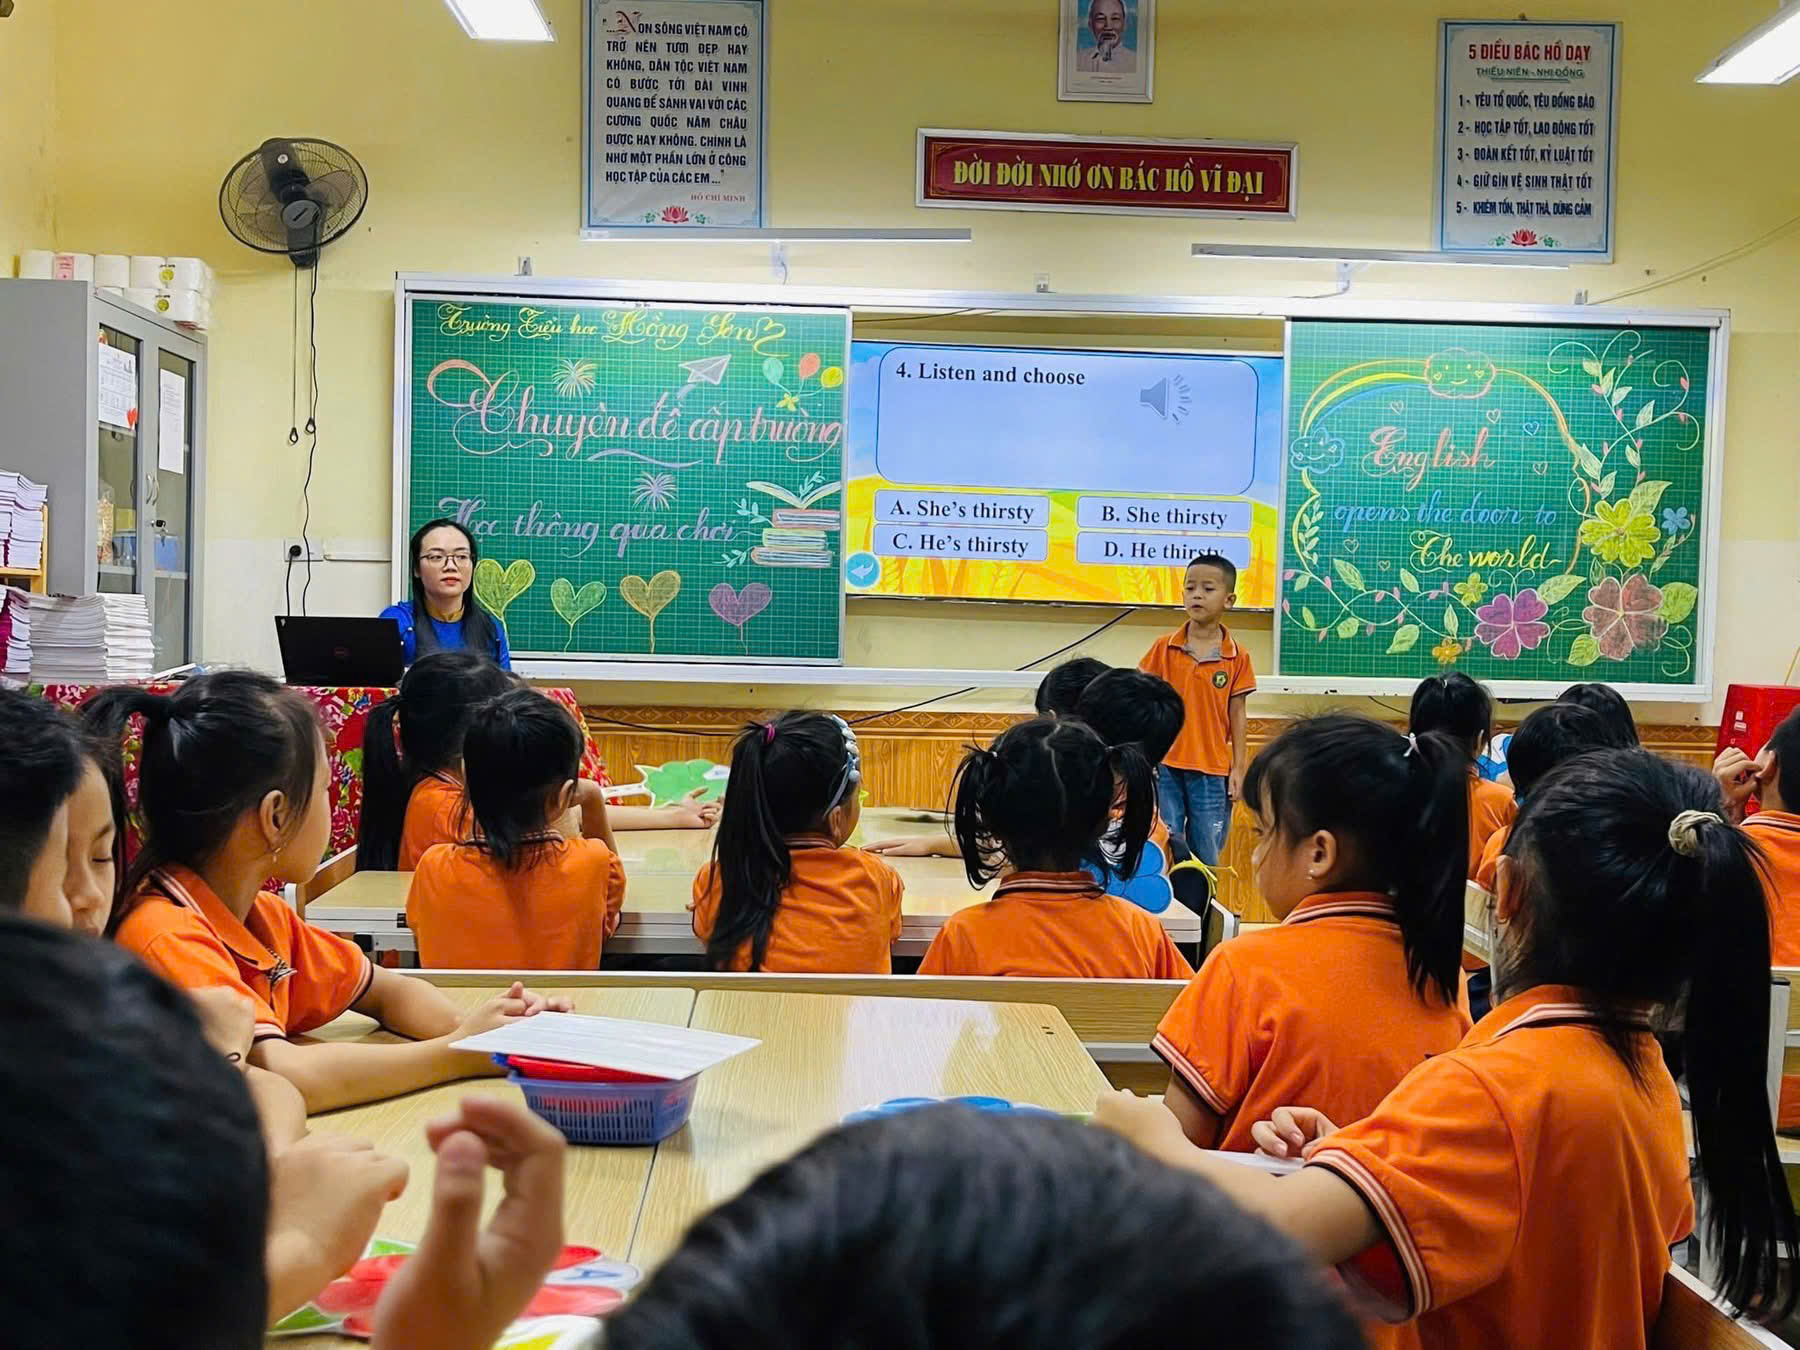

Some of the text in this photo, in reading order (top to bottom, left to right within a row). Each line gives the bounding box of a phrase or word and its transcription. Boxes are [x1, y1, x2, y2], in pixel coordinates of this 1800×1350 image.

[655, 21, 682, 35] SÔNG
[685, 22, 705, 37] VIỆT
[708, 24, 731, 36] NAM
[735, 23, 748, 36] CÓ
[607, 37, 747, 56] TRỞ NÊN TƯƠI ĐẸP HAY
[1469, 44, 1477, 60] 5
[1514, 41, 1541, 60] BÁC
[1566, 45, 1591, 65] DẠY
[649, 59, 671, 71] DÂN
[675, 60, 694, 74] TỘC
[698, 60, 719, 75] VIỆT
[724, 63, 747, 73] NAM
[607, 76, 747, 92] CÓ BƯỚC TỚI ĐÀI VINH
[606, 94, 747, 111] QUANG ĐỂ SÁNH VAI VỚI CÁC
[1474, 91, 1491, 107] YÊU
[1533, 92, 1549, 107] YÊU
[1577, 93, 1595, 108] BÀO
[606, 114, 747, 129] CƯỜNG QUỐC NĂM CHÂU
[1474, 121, 1492, 136] HỌC
[1495, 119, 1511, 136] TẬP
[1534, 122, 1550, 134] LAO
[1552, 119, 1576, 137] ĐỘNG
[1579, 119, 1595, 135] TỐT
[606, 133, 633, 147] ĐƯỢC
[636, 135, 656, 145] HAY
[700, 134, 732, 147] CHÍNH
[734, 135, 747, 148] LÀ
[606, 151, 627, 163] NHỜ
[630, 151, 650, 166] MỘT
[686, 152, 706, 165] LỚN
[719, 153, 747, 166] CÔNG
[1474, 145, 1498, 160] ĐOÀN
[1501, 144, 1517, 160] KẾT
[1554, 146, 1575, 164] LUẬT
[1578, 145, 1593, 162] TỐT
[606, 171, 626, 184] HỌC
[629, 169, 647, 185] TẬP
[650, 168, 670, 183] CỦA
[672, 171, 692, 183] CÁC
[954, 153, 1264, 202] ĐỜI ĐỜI NHỚ ƠN BÁC HỒ VĨ ĐẠI
[1511, 172, 1523, 190] VỆ
[1525, 176, 1548, 188] SINH
[1551, 173, 1573, 191] THẬT
[1576, 172, 1592, 188] TỐT
[1575, 197, 1592, 215] CẢM
[896, 361, 1085, 386] 4. Listen and choose
[688, 401, 747, 465] cấp
[1361, 426, 1496, 492] English
[890, 499, 911, 515] A.
[973, 502, 1034, 524] thirsty
[1102, 505, 1227, 530] B. She thirsty
[1334, 489, 1557, 533] opens the door to
[514, 499, 600, 559] thông
[608, 520, 671, 559] qua
[677, 507, 738, 542] chơi
[893, 532, 913, 549] C.
[968, 536, 1029, 558] thirsty
[1104, 541, 1124, 557] D.
[1131, 542, 1157, 558] He
[1409, 530, 1562, 573] The world
